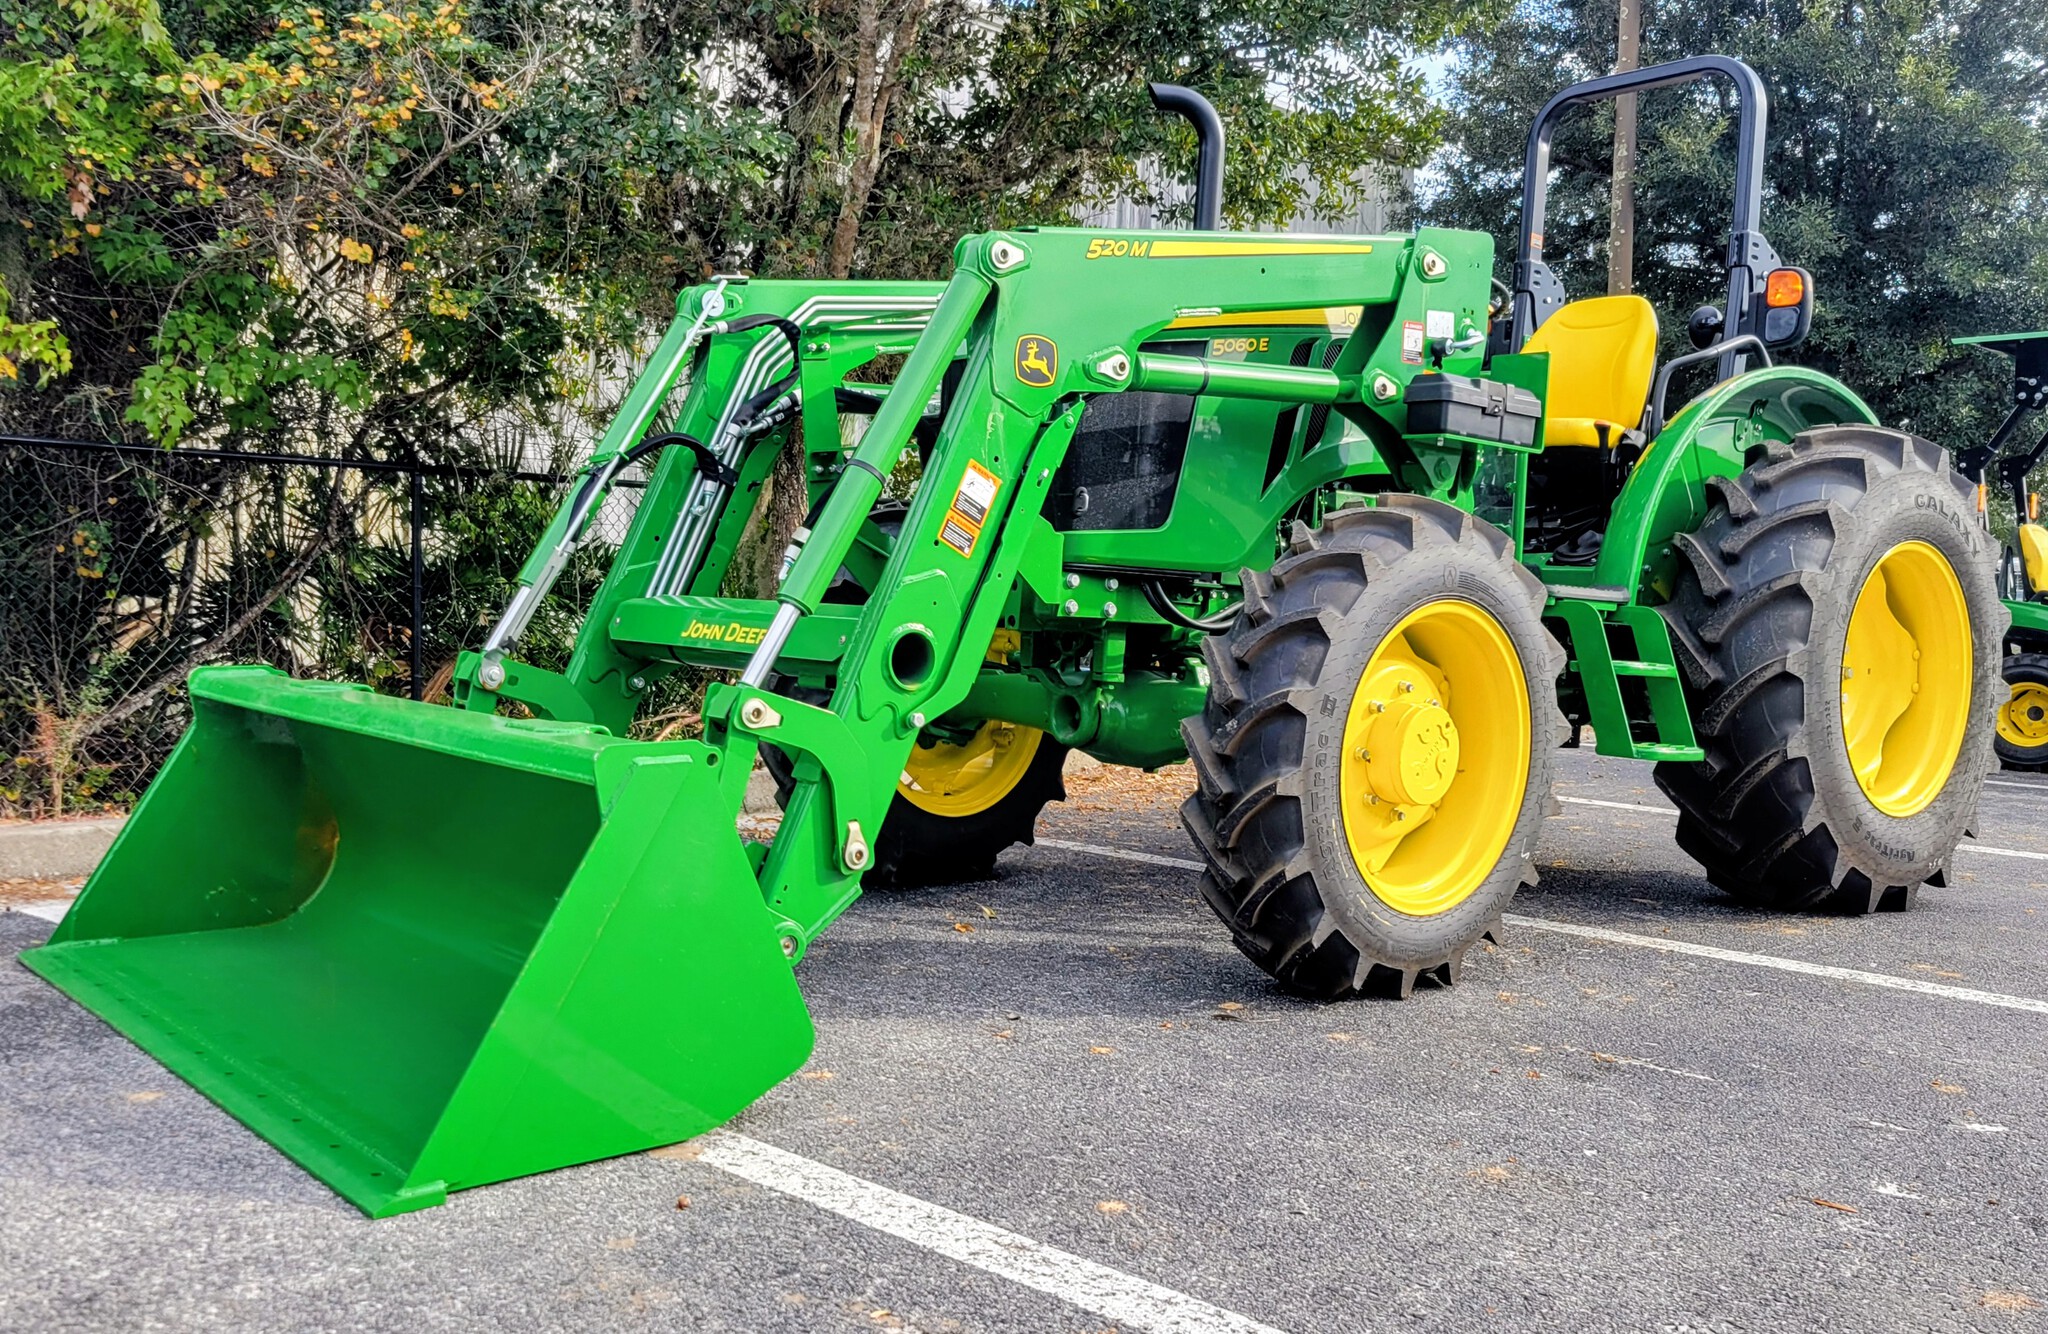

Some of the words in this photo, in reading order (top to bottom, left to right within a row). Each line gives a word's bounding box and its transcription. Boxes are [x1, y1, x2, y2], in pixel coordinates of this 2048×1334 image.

[1914, 493, 1980, 559] GALAXY
[681, 619, 726, 640] JOHN
[723, 622, 768, 644] DEE
